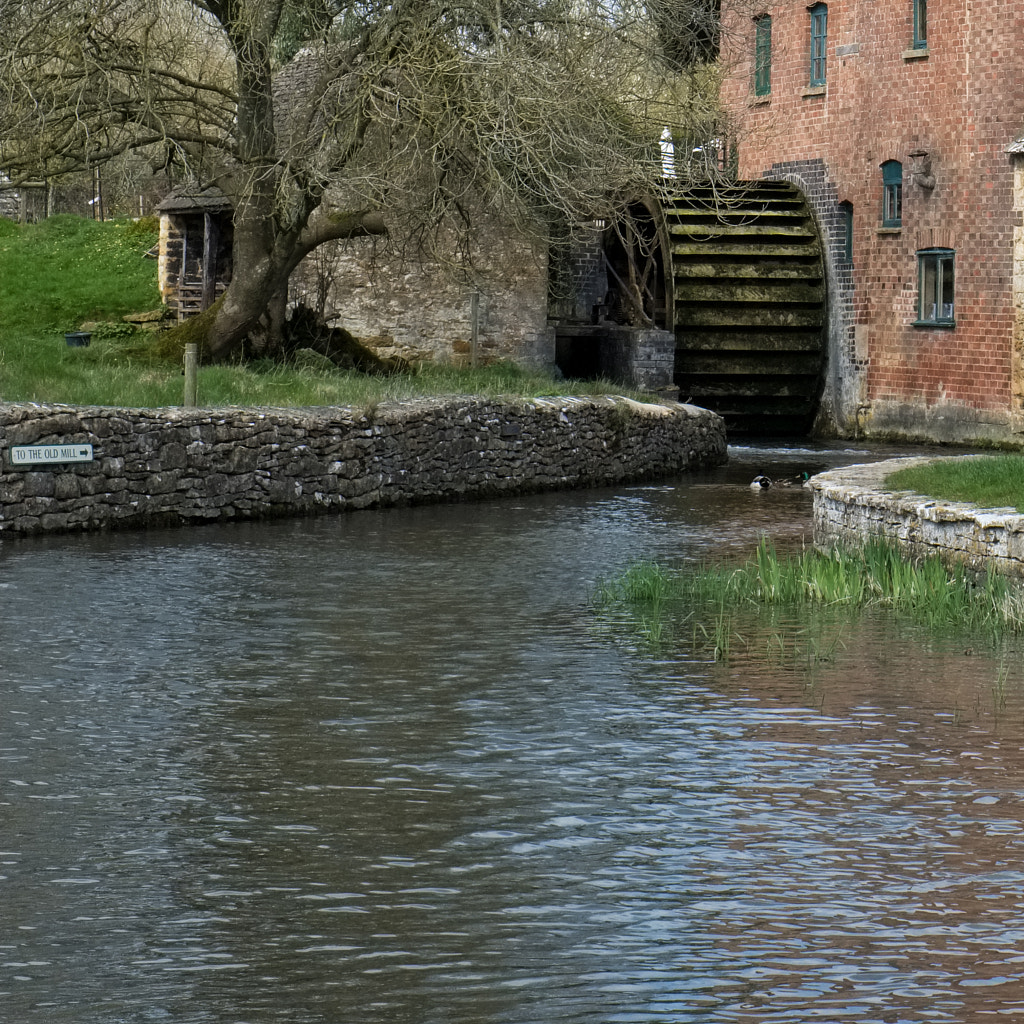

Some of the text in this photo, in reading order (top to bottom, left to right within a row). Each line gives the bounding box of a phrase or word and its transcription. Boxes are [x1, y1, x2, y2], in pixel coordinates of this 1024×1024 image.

[16, 448, 77, 460] TO THE OLD MILL
